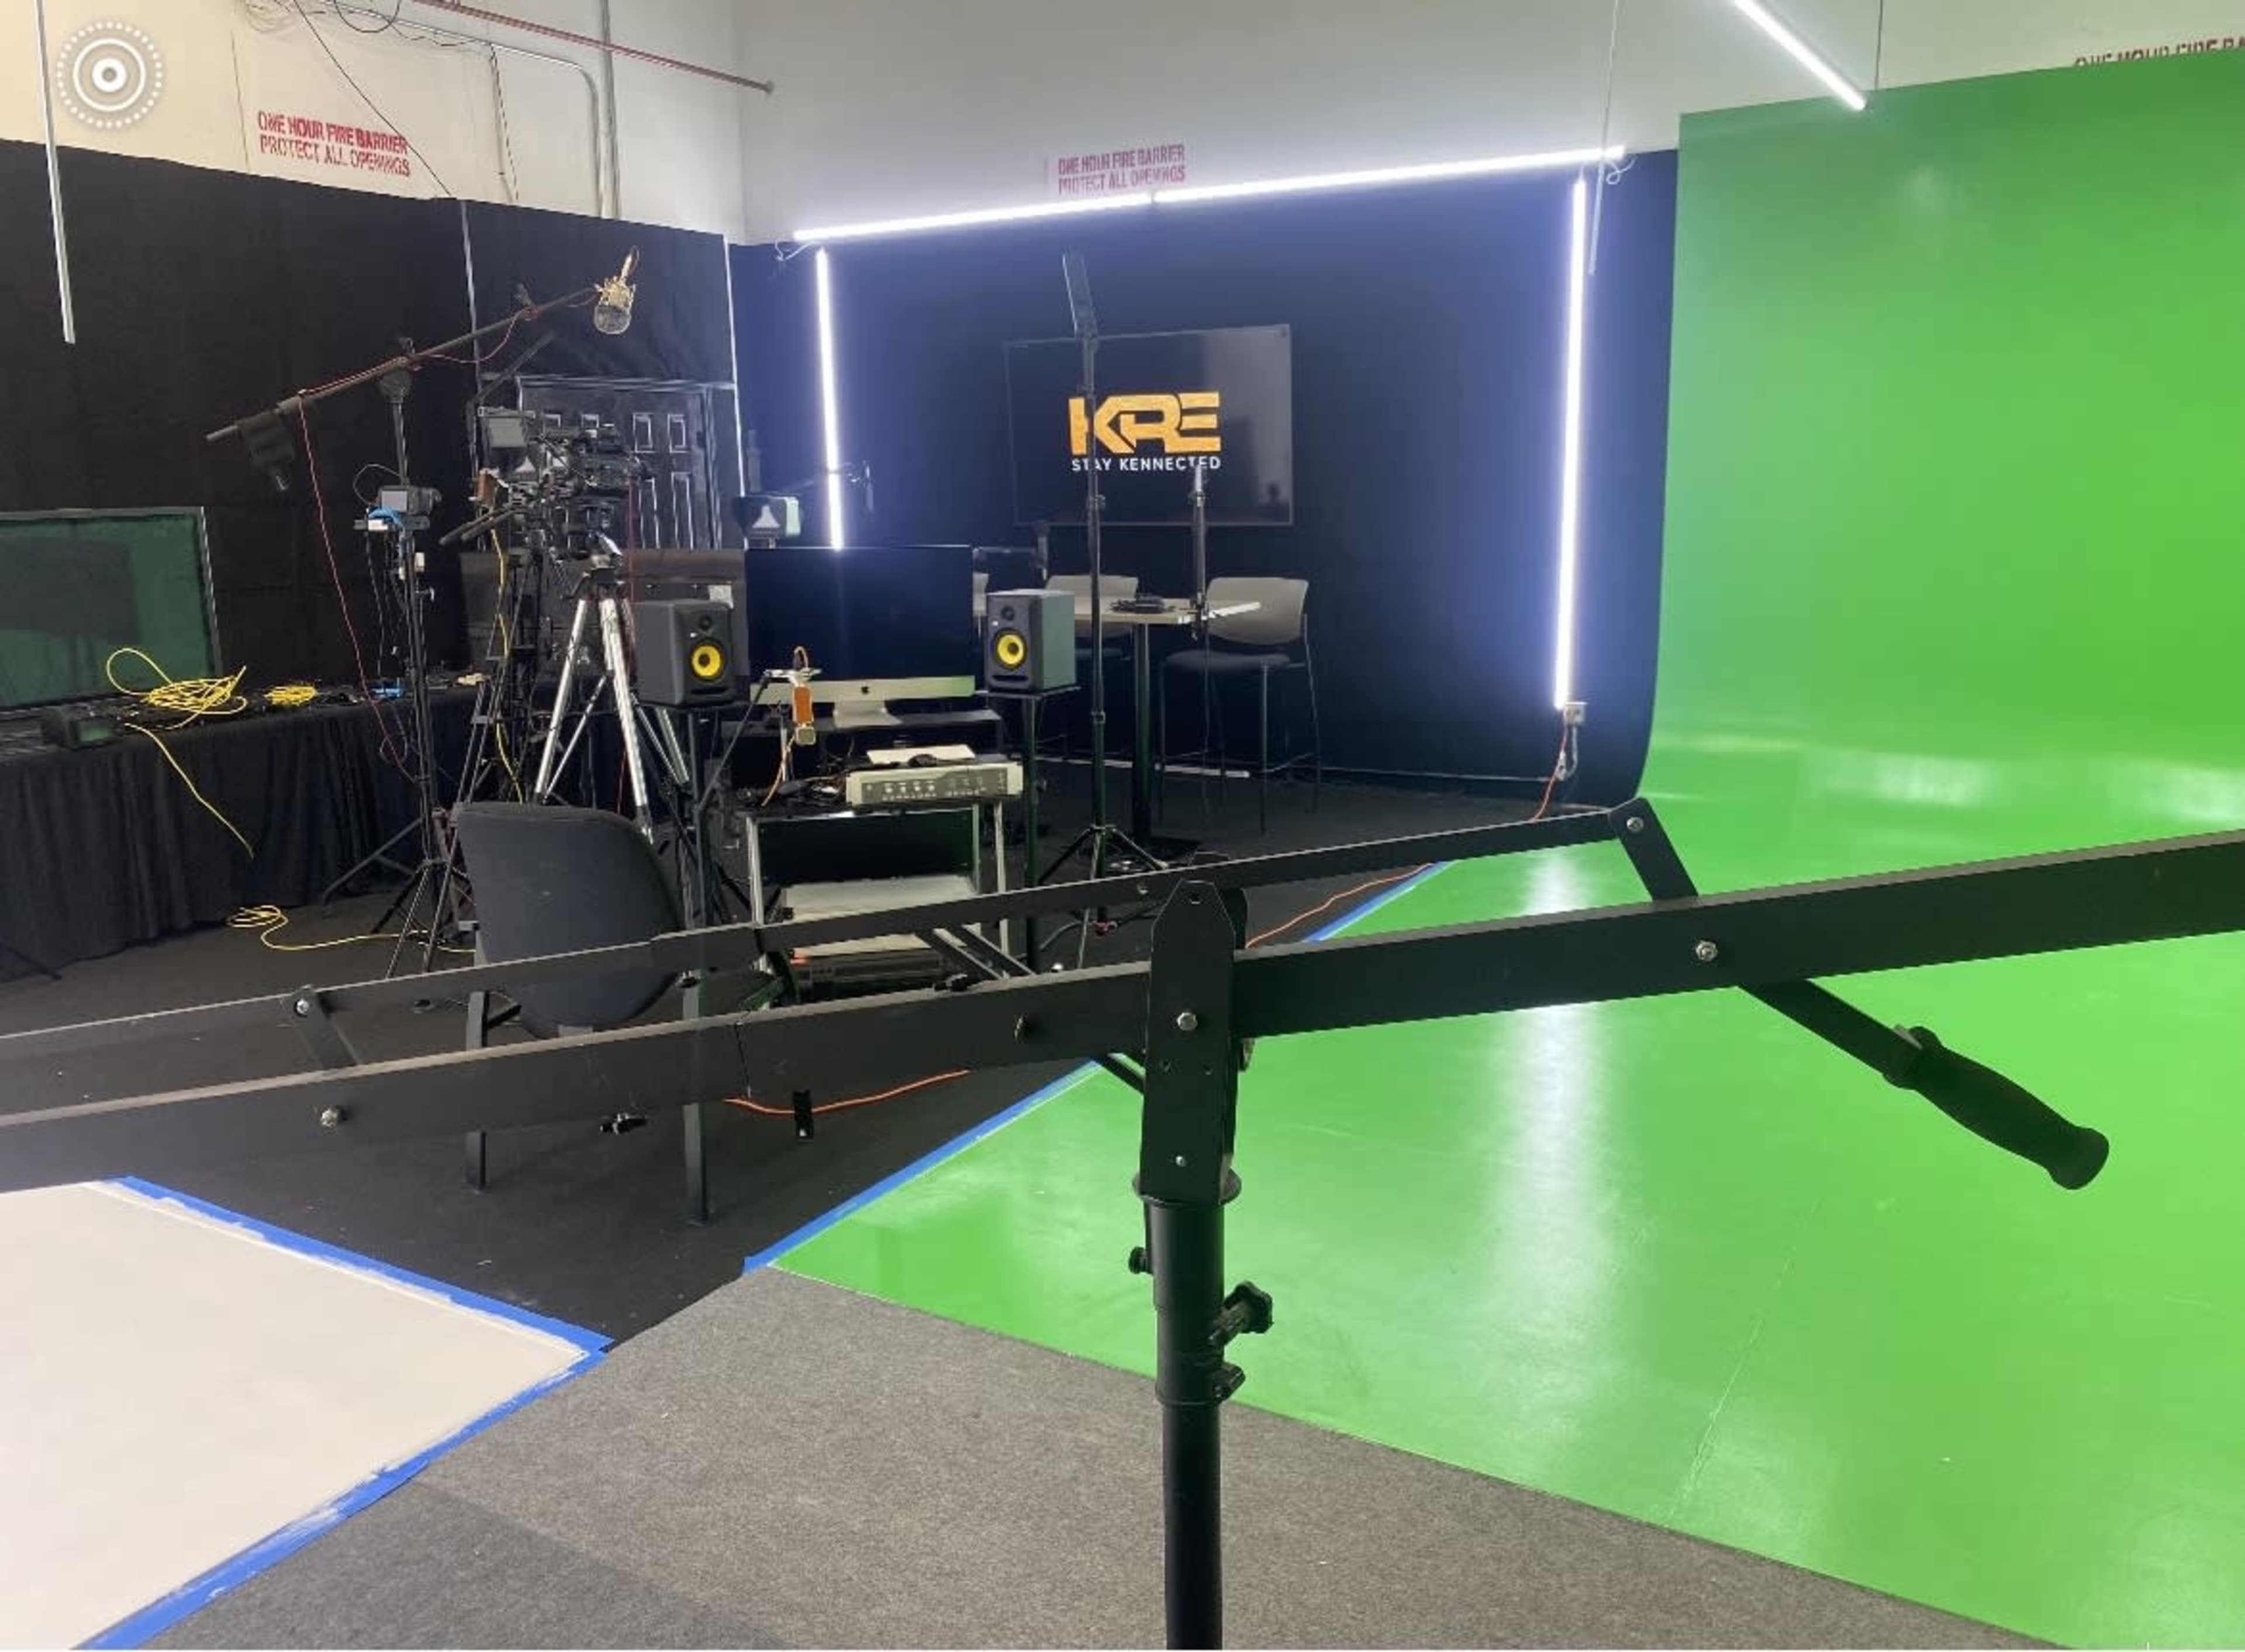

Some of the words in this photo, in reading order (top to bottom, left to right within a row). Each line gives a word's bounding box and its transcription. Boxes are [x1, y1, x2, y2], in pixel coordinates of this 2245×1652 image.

[287, 116, 324, 140] HOUR
[326, 123, 354, 146] FIRE
[355, 128, 407, 154] BARRIER
[260, 134, 319, 164] PROTECT
[324, 145, 348, 165] ALL
[351, 149, 410, 177] OPENINGS
[1082, 153, 1110, 173] HOUR
[1112, 151, 1136, 169] FIRE
[1137, 144, 1184, 165] BARRIER
[1058, 174, 1105, 195] PROTECT
[1109, 171, 1128, 189] ALL
[1068, 390, 1221, 456] KRE
[1071, 458, 1112, 472] STAY
[1119, 455, 1221, 471] KENNECTED
